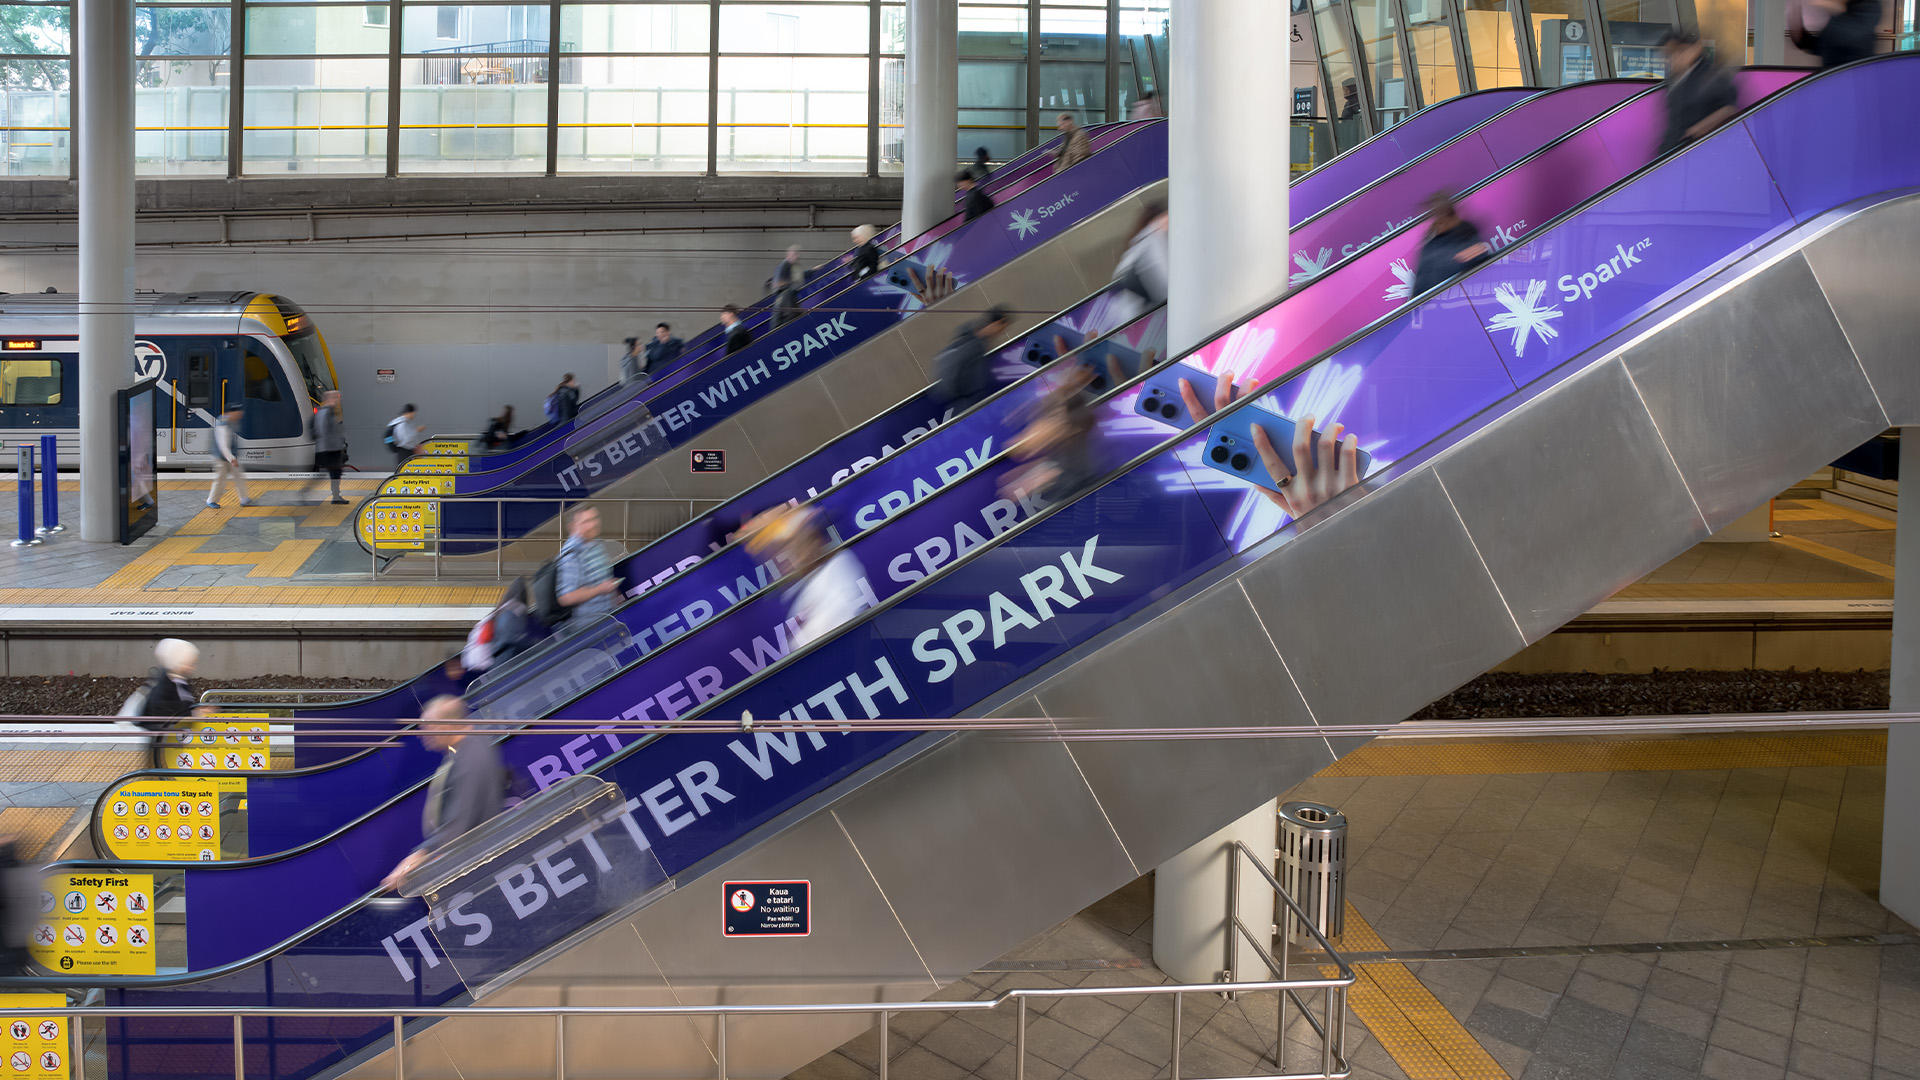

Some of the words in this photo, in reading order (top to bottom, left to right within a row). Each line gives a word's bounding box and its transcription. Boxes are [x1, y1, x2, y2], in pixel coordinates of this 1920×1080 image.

[1038, 193, 1074, 218] Spark
[1557, 244, 1643, 302] Spark
[556, 454, 602, 492] IT'S
[602, 399, 702, 466] BETTER
[698, 359, 772, 410] WITH
[772, 311, 857, 371] SPARK
[381, 890, 494, 982] IT'S
[495, 760, 736, 920] BETTER
[728, 656, 909, 780] WITH
[912, 535, 1124, 683] SPARK
[70, 878, 102, 887] Safety
[105, 878, 129, 886] First
